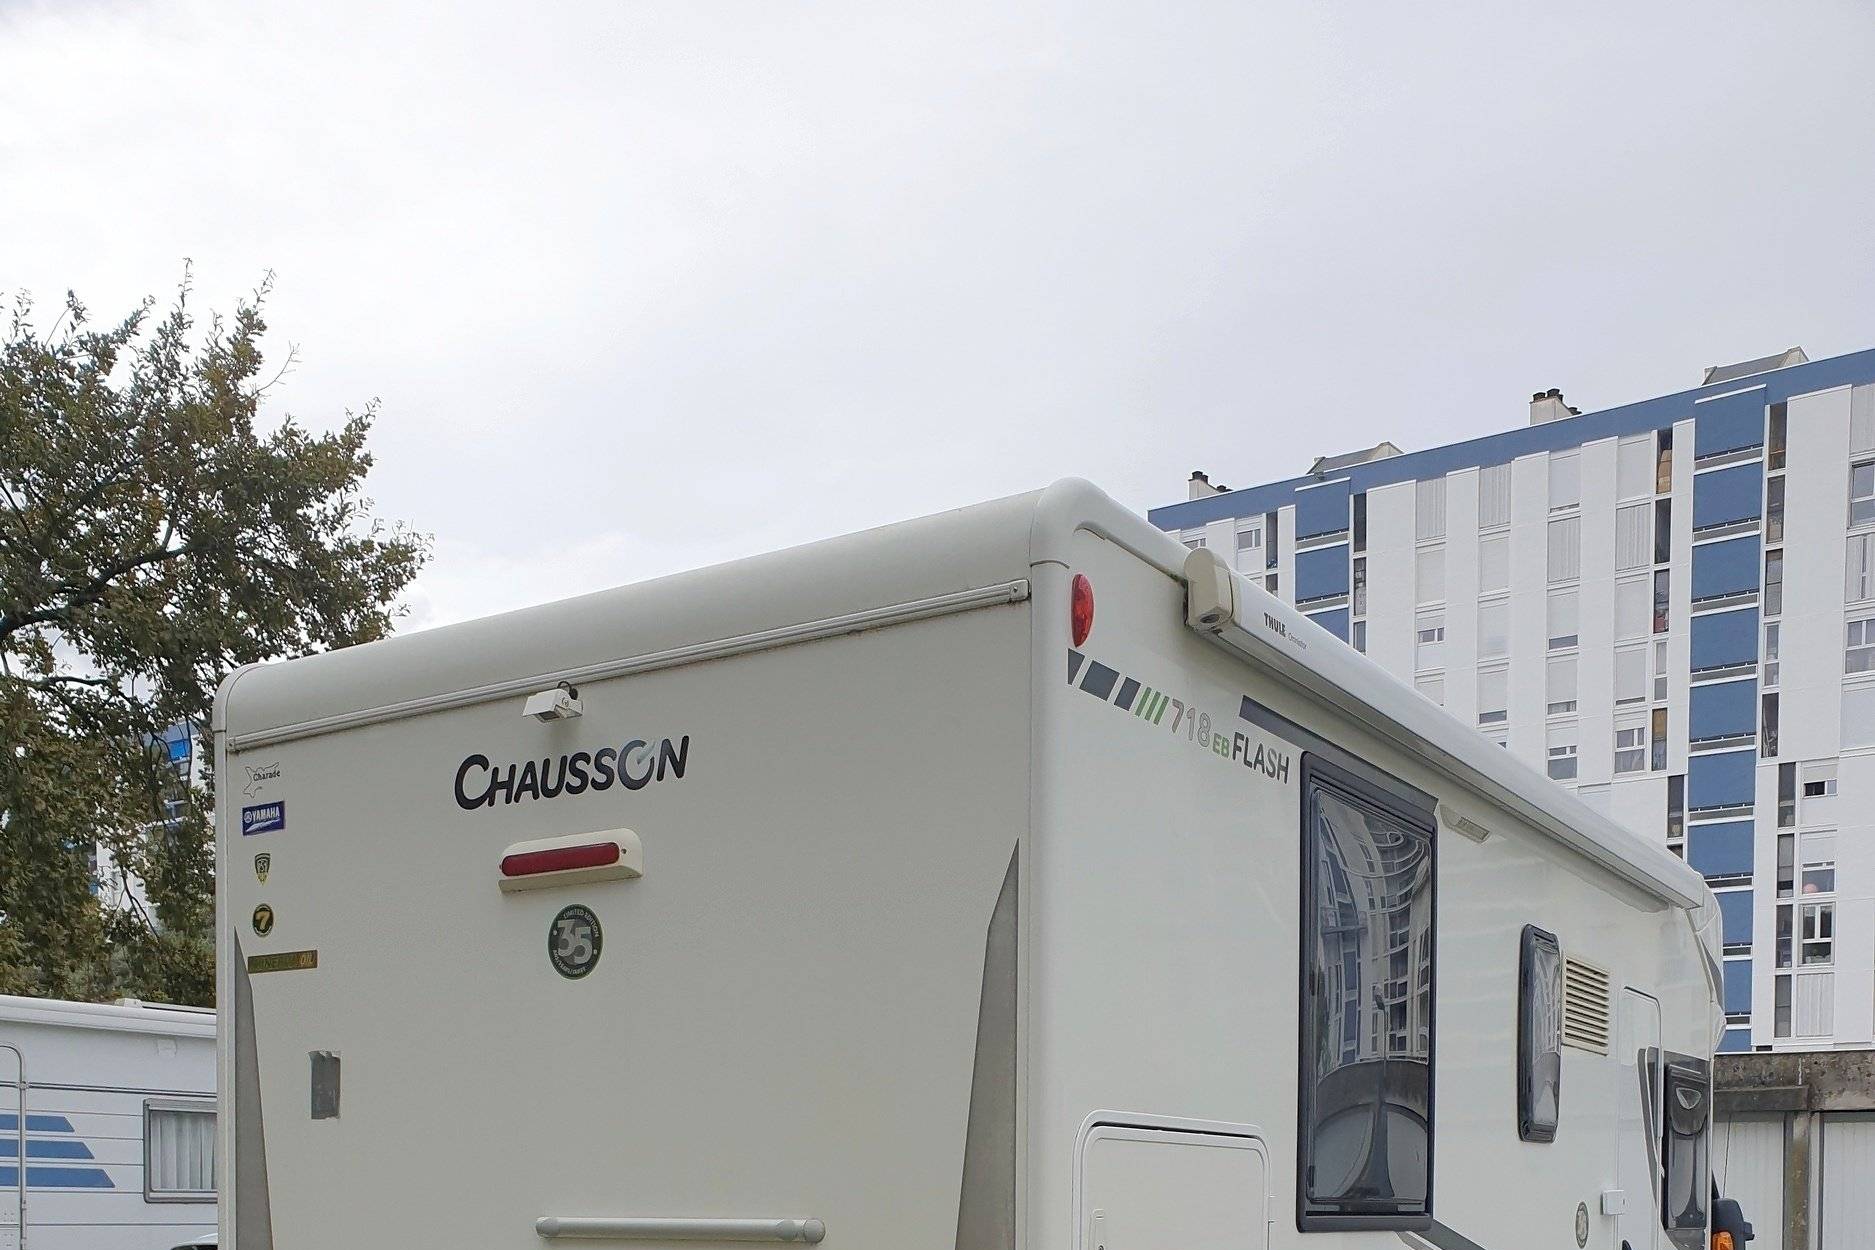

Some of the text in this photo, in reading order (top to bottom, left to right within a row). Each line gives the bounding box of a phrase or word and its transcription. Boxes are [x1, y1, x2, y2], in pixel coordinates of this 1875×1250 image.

[1263, 612, 1286, 638] THULE
[1170, 697, 1290, 785] 718 EB FLASH
[252, 769, 281, 782] Charade
[454, 735, 690, 810] CHAUSSON
[251, 805, 280, 822] YAMAHA
[255, 911, 270, 930] 7
[557, 918, 593, 964] 35
